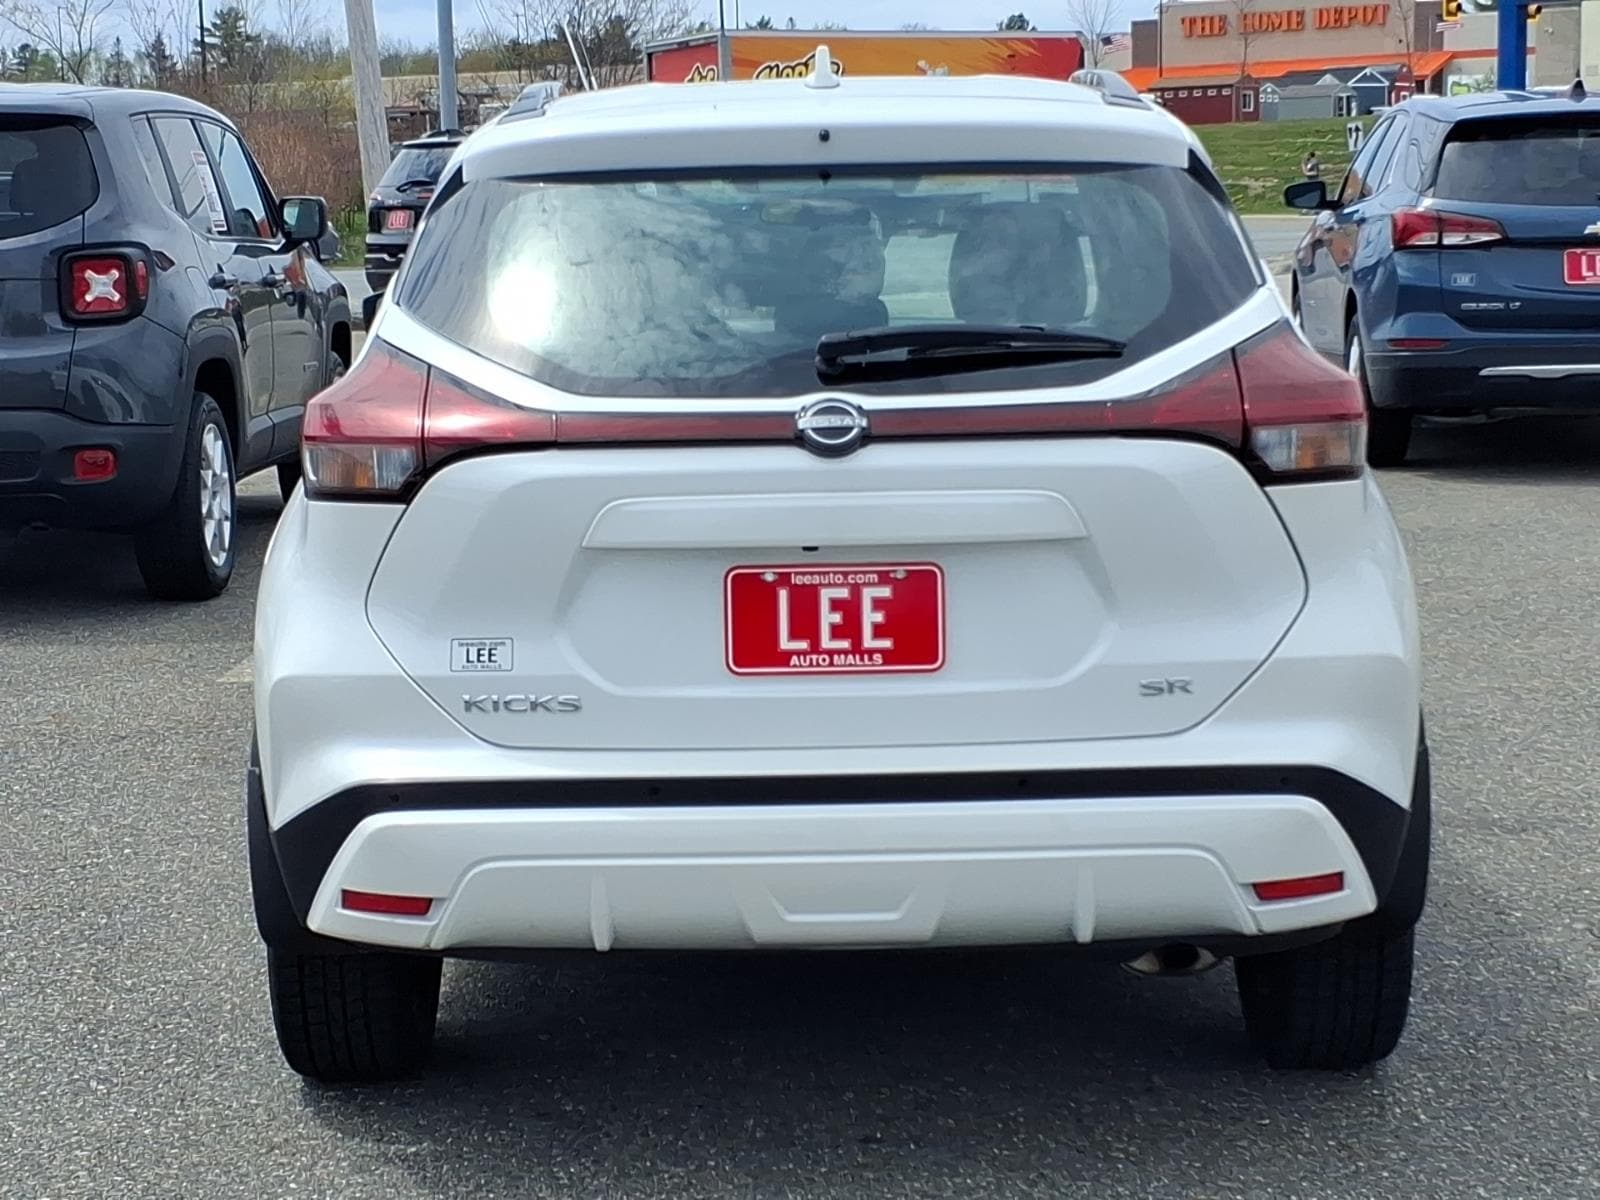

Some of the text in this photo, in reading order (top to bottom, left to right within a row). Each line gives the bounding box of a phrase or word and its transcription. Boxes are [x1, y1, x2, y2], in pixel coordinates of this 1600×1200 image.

[1181, 4, 1389, 38] THE HOME DEPOT
[791, 572, 878, 585] leeauto.com
[777, 586, 894, 651] LEE
[466, 647, 498, 663] LEE
[790, 653, 883, 666] AUTO MALLS
[1139, 678, 1193, 697] SR
[462, 694, 582, 712] KICKS
